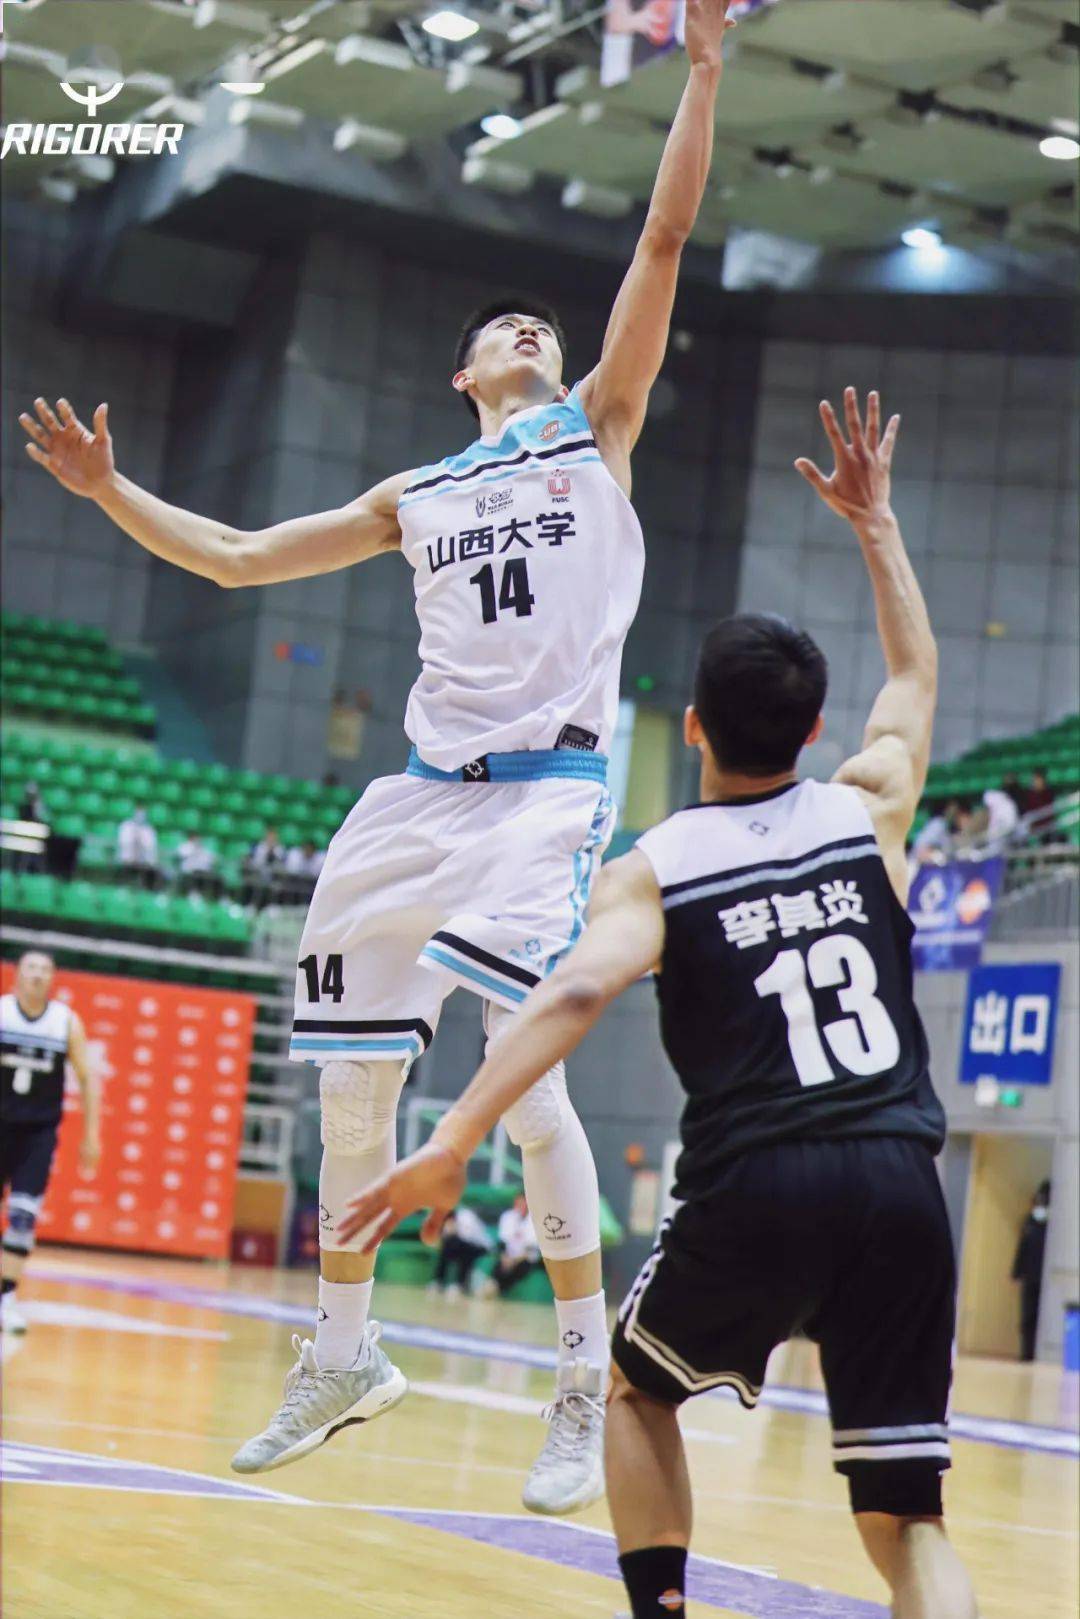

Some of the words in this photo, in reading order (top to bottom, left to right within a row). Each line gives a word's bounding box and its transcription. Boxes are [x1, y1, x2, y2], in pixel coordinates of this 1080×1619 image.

[427, 511, 576, 573] 山西大学
[469, 557, 535, 624] 14
[298, 954, 344, 1003] 14
[753, 933, 900, 1087] 13
[969, 990, 1050, 1055] 出口
